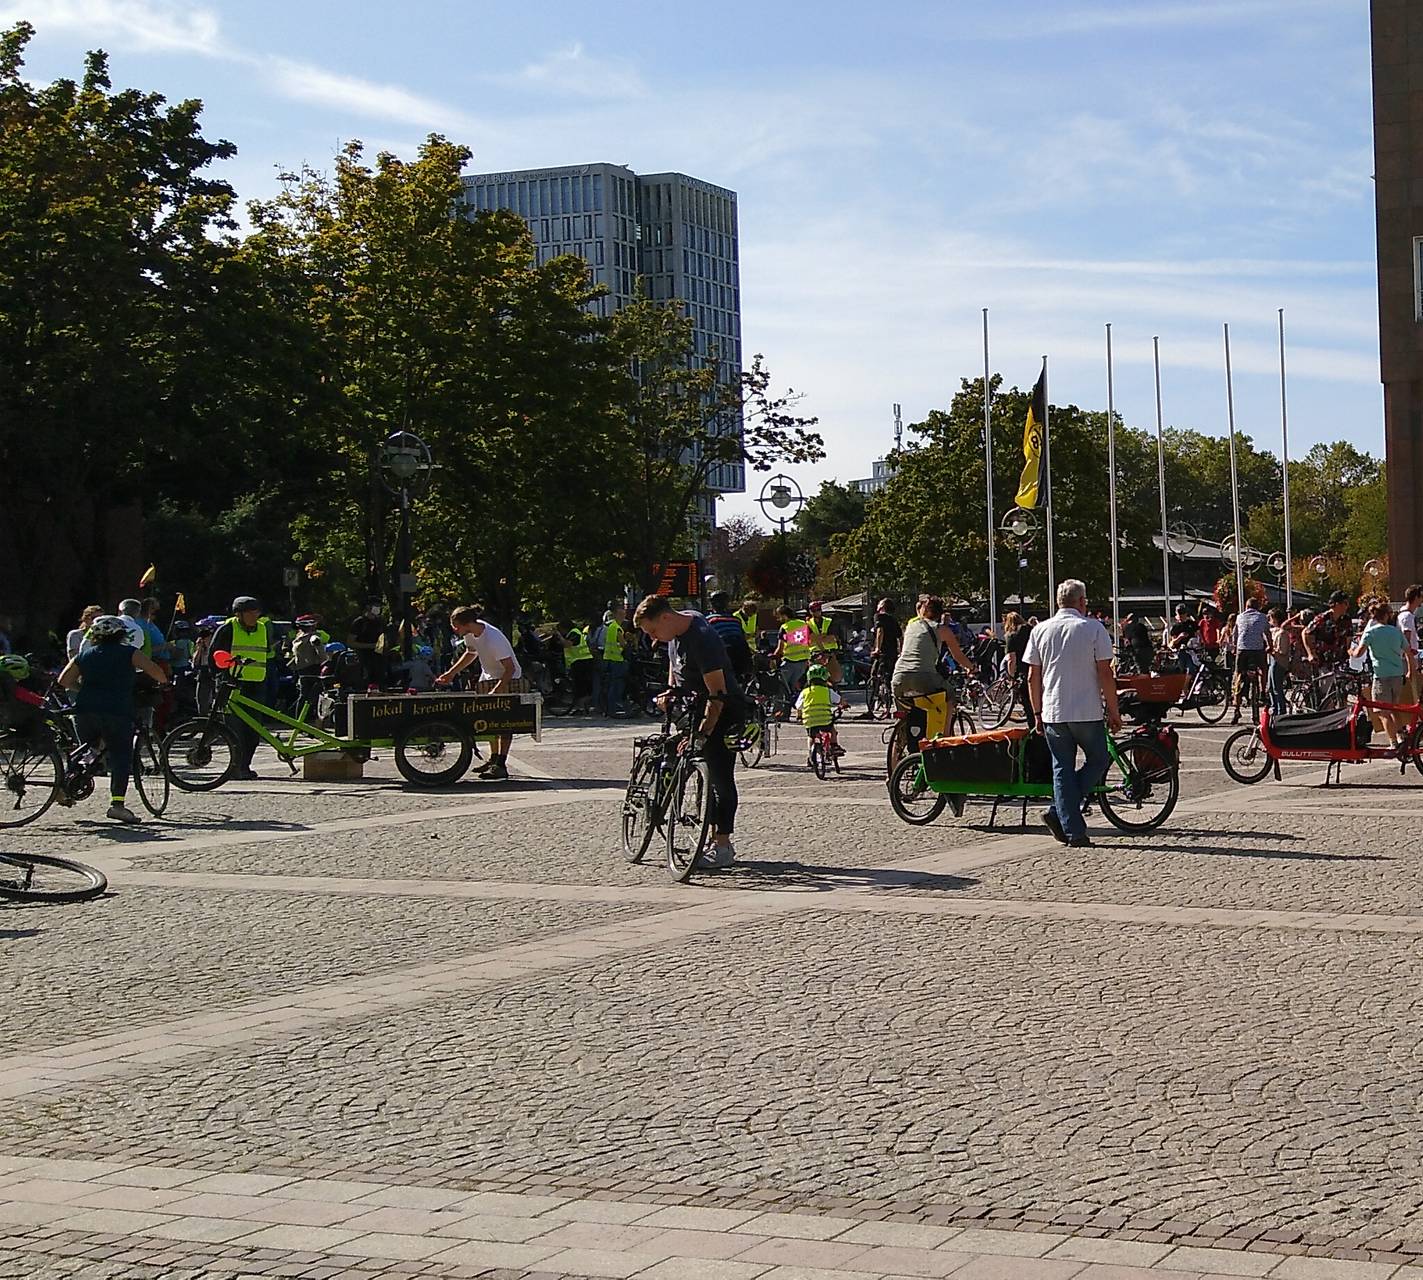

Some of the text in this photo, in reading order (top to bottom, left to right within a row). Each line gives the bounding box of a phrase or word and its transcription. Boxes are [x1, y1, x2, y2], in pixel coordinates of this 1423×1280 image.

[372, 697, 513, 718] lokal kreativ lebendig
